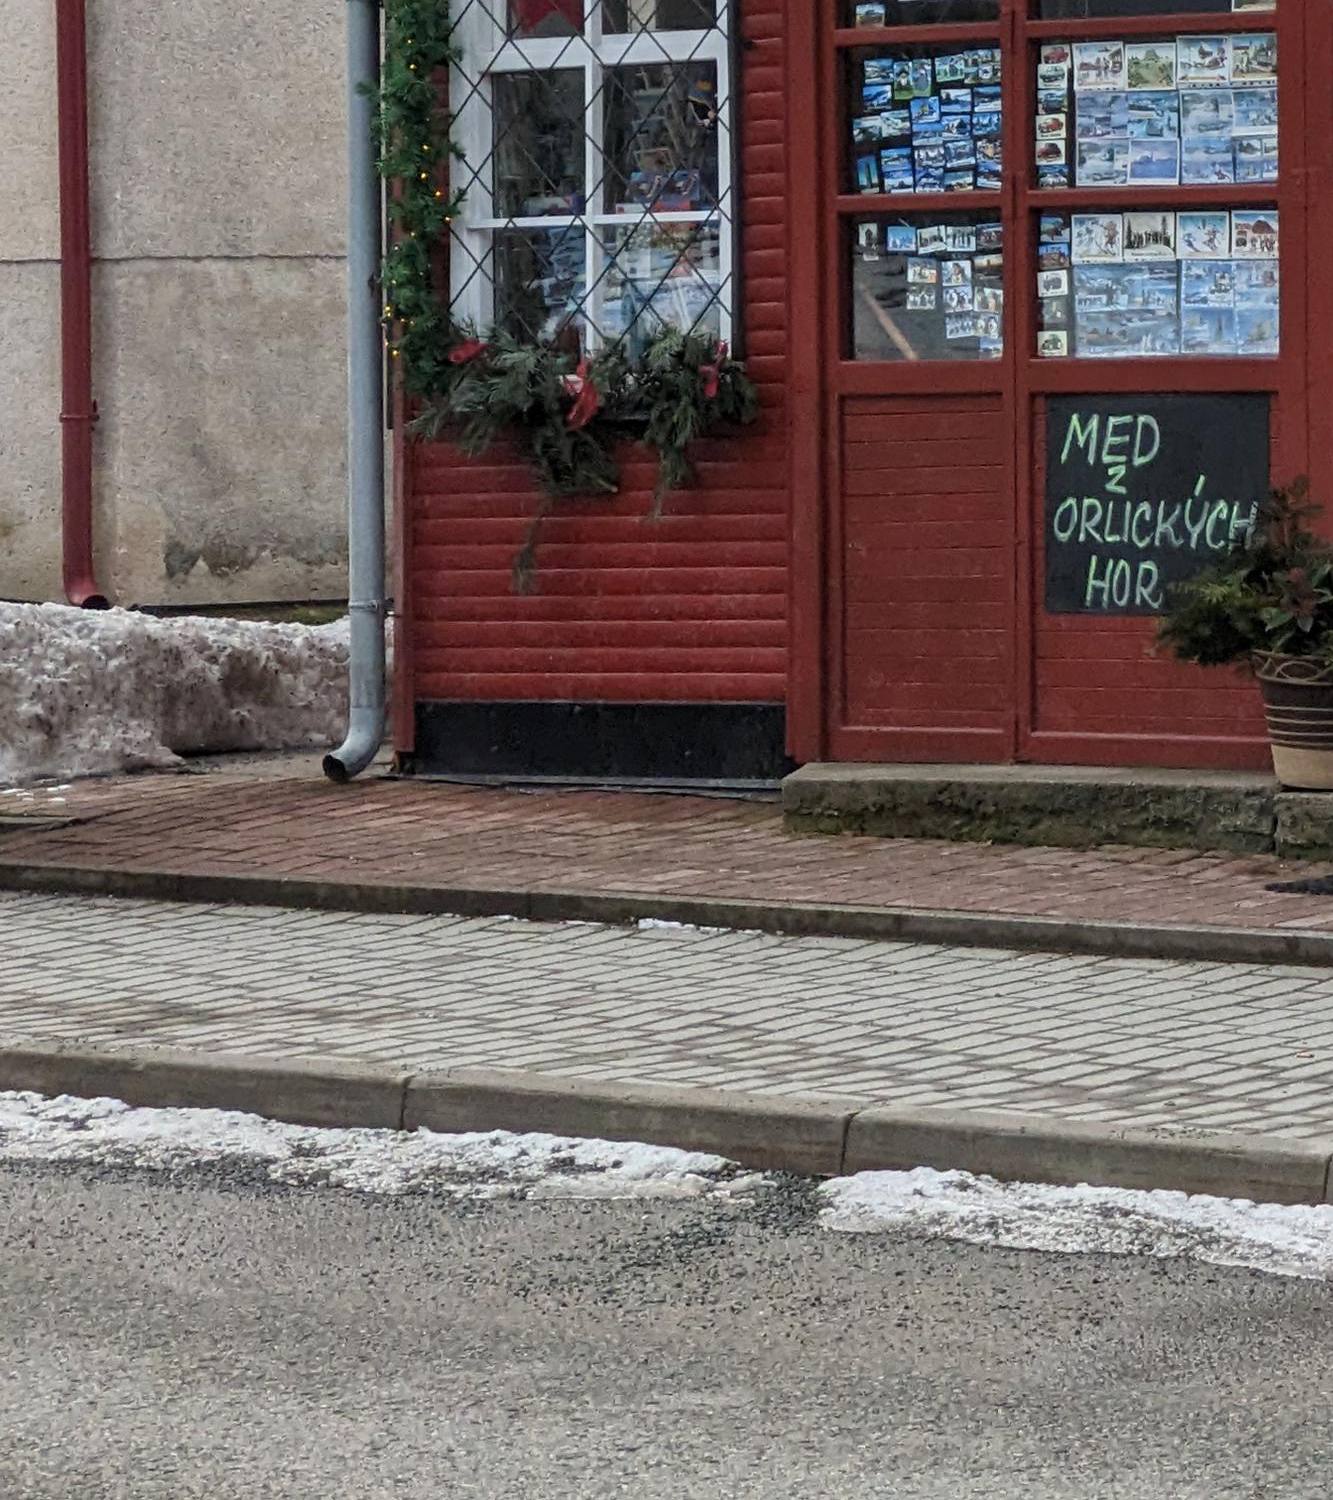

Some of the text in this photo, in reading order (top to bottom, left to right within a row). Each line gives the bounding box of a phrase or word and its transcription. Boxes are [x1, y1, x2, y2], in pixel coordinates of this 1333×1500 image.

[1060, 412, 1161, 467] MED
[1053, 474, 1258, 555] ORLICKÝCH
[1085, 554, 1164, 610] HOR
